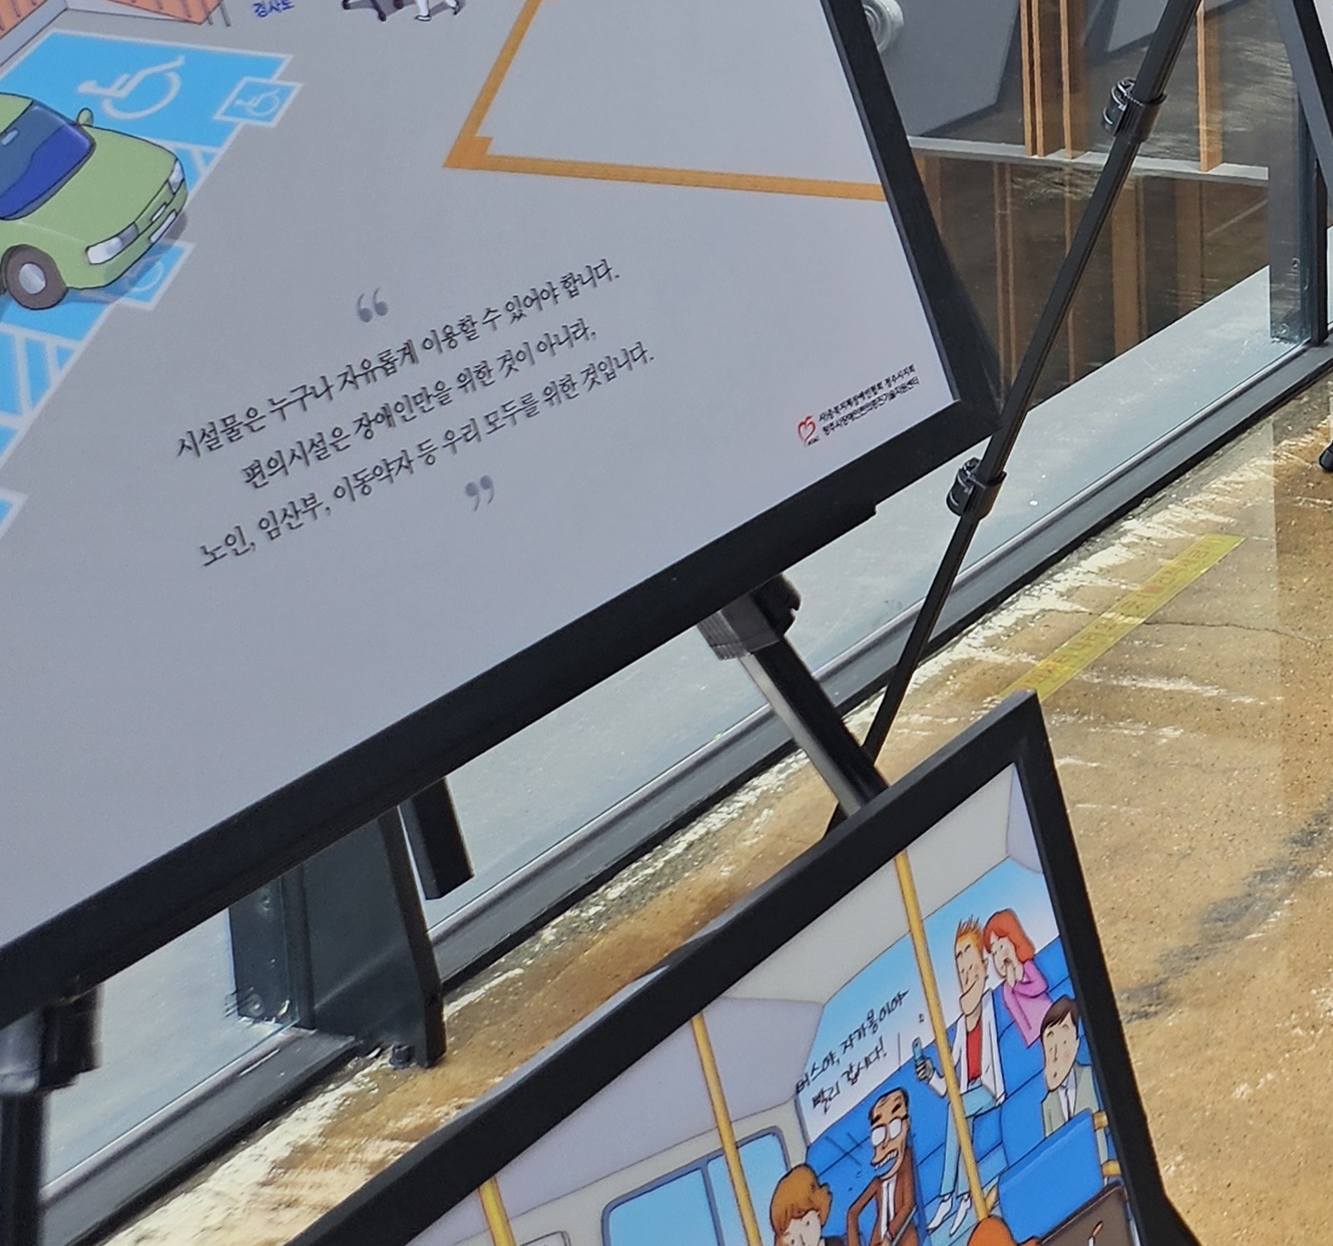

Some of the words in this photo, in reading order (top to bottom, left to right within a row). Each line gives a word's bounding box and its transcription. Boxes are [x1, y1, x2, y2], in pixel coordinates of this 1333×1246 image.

[177, 407, 267, 458] 시설물은
[267, 375, 334, 421] 누구나
[336, 339, 419, 392] 자유롭게
[421, 314, 480, 354] 이용할
[482, 307, 502, 331] 수
[504, 281, 560, 324] 있어야
[559, 258, 620, 299] 합니다.
[242, 426, 351, 489] 편의시설은
[352, 380, 453, 440] 장애인만을
[456, 360, 496, 394] 위한
[496, 342, 535, 378] 것이
[536, 318, 596, 356] 아니라,
[200, 525, 256, 567] 노인,
[258, 492, 331, 541] 임산부,
[333, 449, 415, 502] 이동약자
[416, 438, 439, 466] 등
[442, 418, 482, 454] 우리
[483, 392, 540, 435] 모두를
[542, 374, 580, 406] 위한
[580, 341, 654, 392] 것입니다.
[796, 1050, 840, 1095] 버스야,
[840, 989, 910, 1055] 자가용이야
[812, 1080, 842, 1114] 빨리
[841, 1036, 887, 1086] 갑시다!
